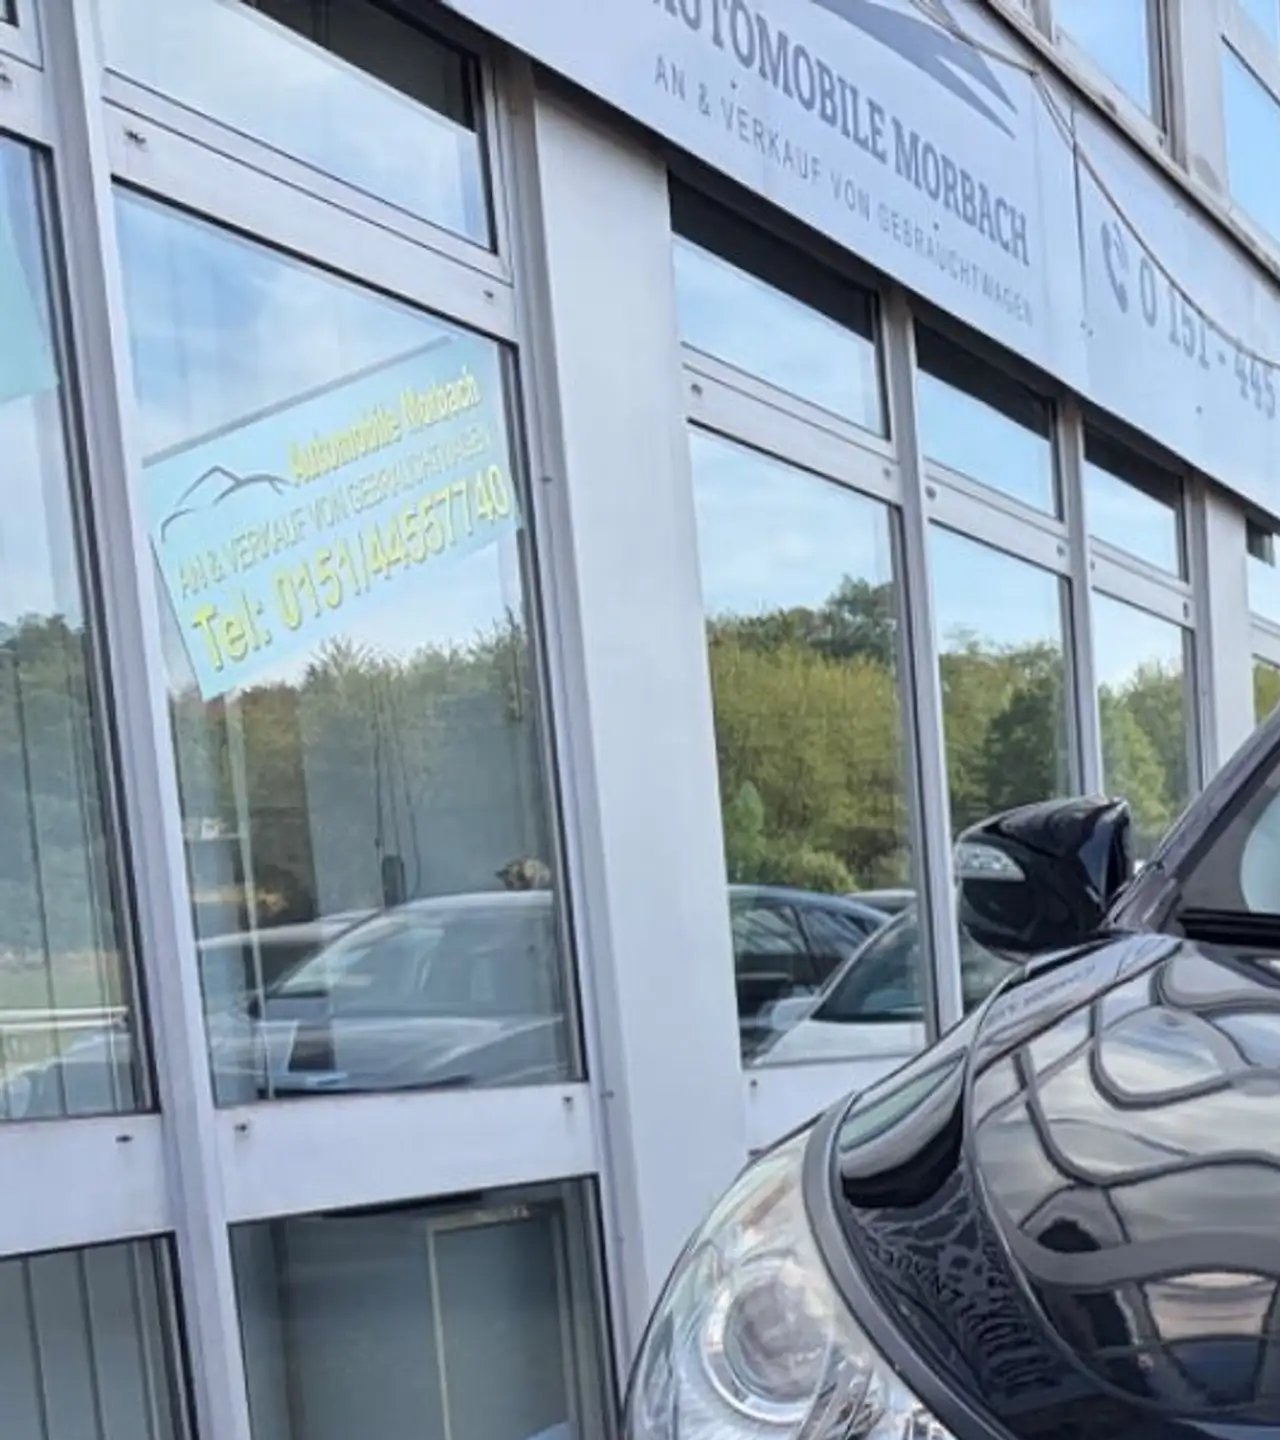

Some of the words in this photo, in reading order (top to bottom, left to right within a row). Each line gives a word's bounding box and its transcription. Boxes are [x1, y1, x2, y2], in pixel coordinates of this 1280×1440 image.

[652, 0, 888, 164] TOMOBILE
[893, 114, 1030, 267] MORBACH
[655, 54, 685, 101] AN
[698, 82, 711, 117] &
[720, 95, 824, 187] VERKAUF
[830, 172, 871, 224] VON
[877, 203, 1034, 328] GEBRAUCHTWAGEN
[402, 365, 481, 428] Morbach
[191, 590, 273, 673] Tel:
